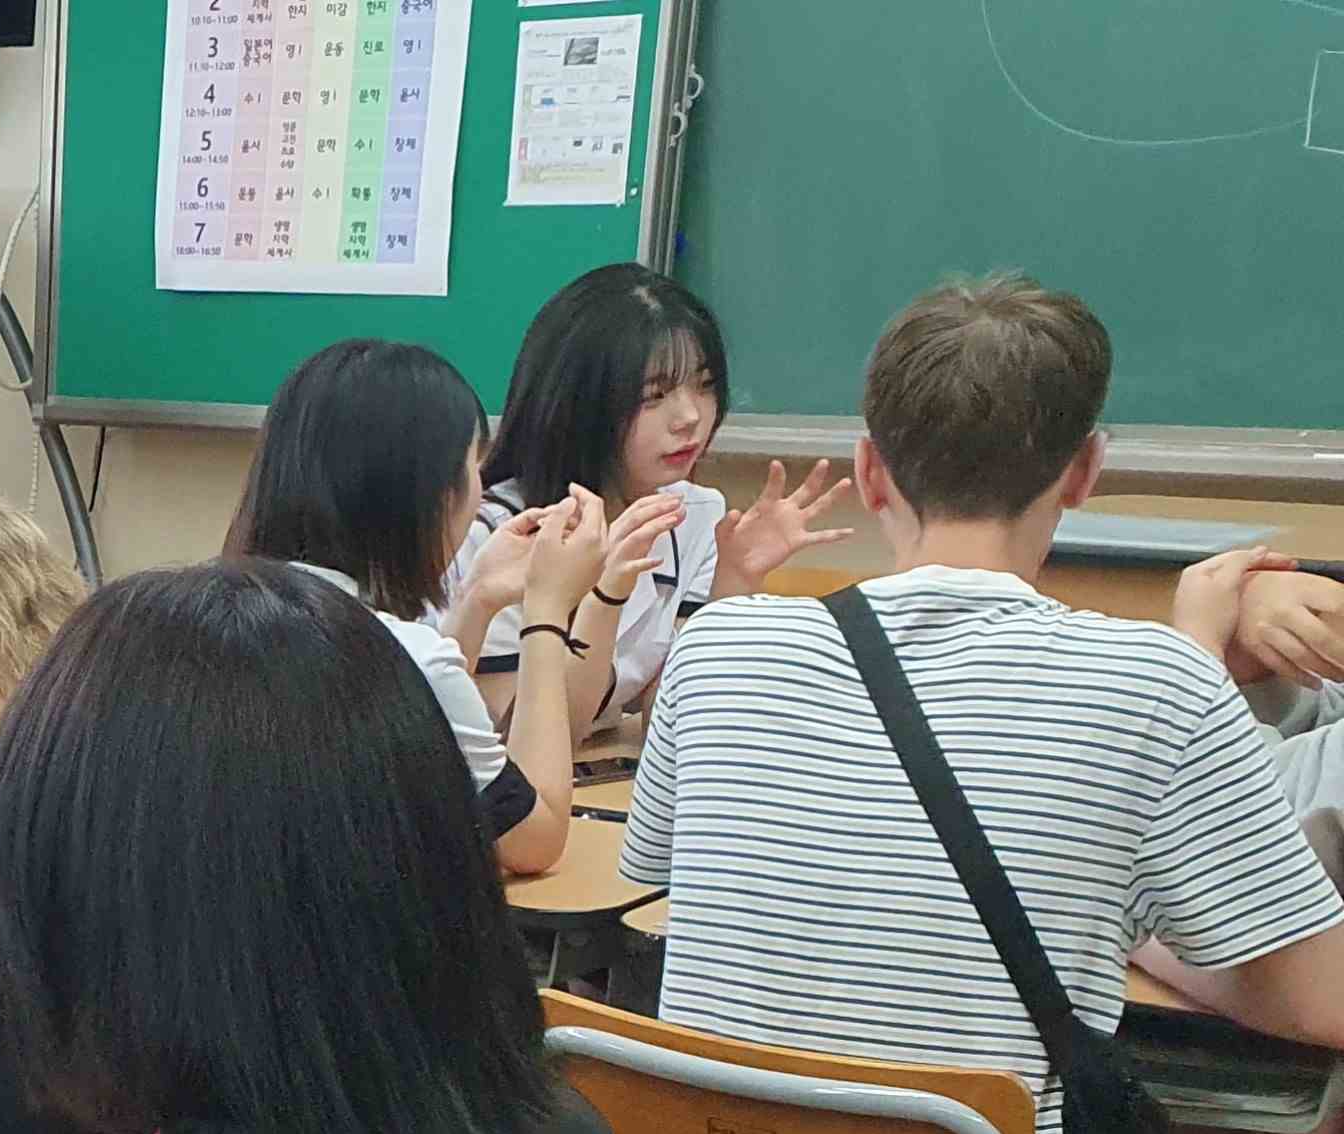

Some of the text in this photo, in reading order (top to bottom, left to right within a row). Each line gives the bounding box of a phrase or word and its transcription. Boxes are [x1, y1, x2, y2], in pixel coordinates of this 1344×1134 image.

[208, 36, 218, 58] 3
[204, 83, 216, 104] 4
[201, 130, 212, 151] 5
[197, 177, 208, 197] 6
[194, 222, 207, 243] 7
